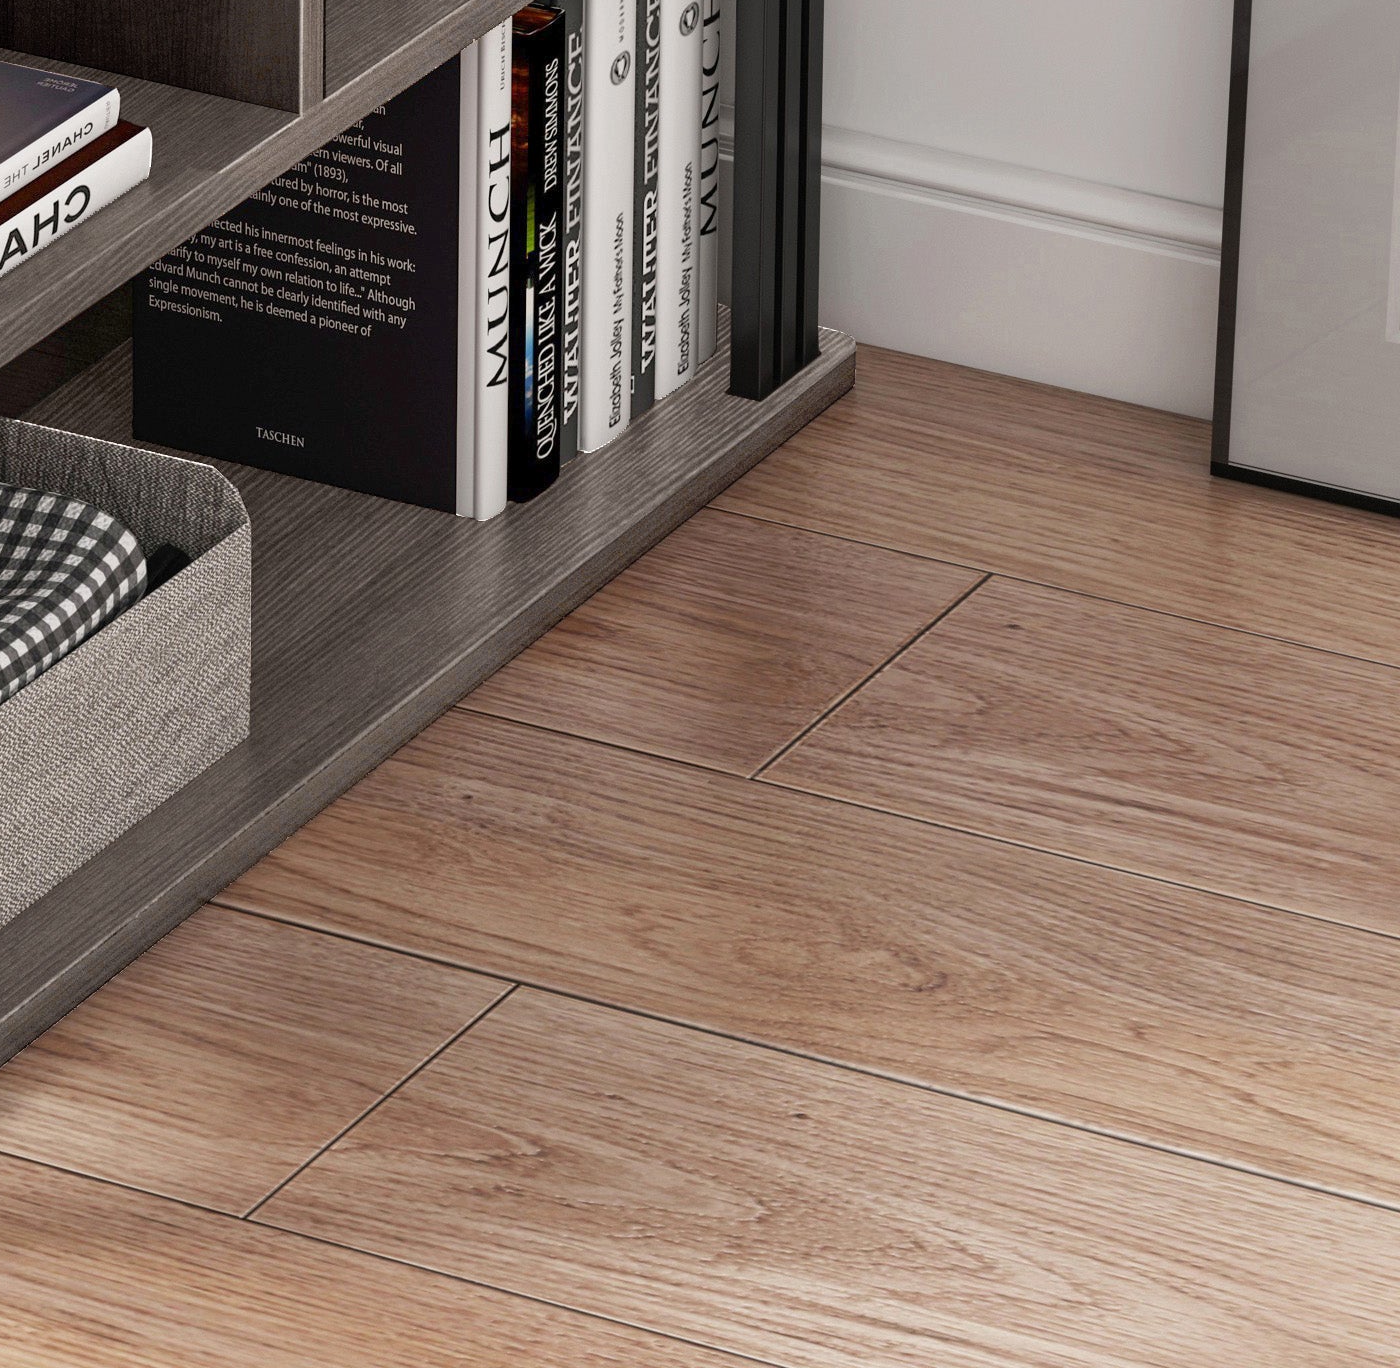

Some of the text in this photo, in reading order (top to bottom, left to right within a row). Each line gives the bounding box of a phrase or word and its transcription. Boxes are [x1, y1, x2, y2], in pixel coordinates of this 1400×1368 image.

[544, 57, 559, 193] DREW SIMMONS
[331, 150, 374, 169] viewers.
[375, 158, 389, 173] Of
[390, 161, 403, 176] all
[372, 139, 403, 156] visual
[313, 163, 349, 184] (1893),
[682, 161, 693, 199] Moon
[278, 196, 299, 209] one
[300, 199, 313, 212] of
[313, 201, 331, 216] the
[332, 208, 360, 223] most
[361, 214, 418, 236] expressive.
[300, 178, 314, 196] by
[315, 182, 350, 203] horror,
[352, 190, 360, 204] is
[361, 193, 380, 209] the
[381, 200, 409, 215] most
[244, 222, 260, 238] his
[261, 227, 314, 250] innermost
[315, 238, 356, 261] feelings
[358, 248, 368, 262] in
[370, 250, 386, 266] his
[386, 257, 416, 273] work:
[614, 212, 625, 250] Moon
[200, 234, 217, 249] my
[218, 238, 233, 251] art
[235, 239, 243, 252] is
[244, 244, 251, 254] a
[253, 242, 274, 259] free
[275, 251, 333, 274] confession,
[334, 264, 347, 276] an
[349, 267, 391, 287] attempt
[486, 122, 510, 388] MUNCH
[682, 242, 692, 264] My
[185, 265, 221, 285] Munch
[222, 277, 259, 294] cannot
[261, 281, 274, 297] be
[276, 286, 310, 307] clearly
[311, 293, 360, 317] identified
[362, 307, 386, 322] with
[387, 314, 407, 330] any
[194, 250, 205, 263] to
[207, 254, 241, 271] myself
[242, 263, 259, 277] my
[260, 267, 283, 280] own
[285, 271, 324, 290] relation
[325, 280, 338, 293] to
[339, 281, 365, 299] life..."
[367, 288, 416, 312] Although
[149, 276, 372, 337] single movement, he is deemed a pioneer of
[149, 294, 223, 322] Expressionism.
[613, 293, 625, 315] My
[677, 266, 693, 375] Elizabeth Jolley
[536, 211, 557, 460] QUENCHED LIKE A WICK
[608, 318, 625, 429] Elizabeth Jolley
[255, 426, 305, 448] TASCHEN
